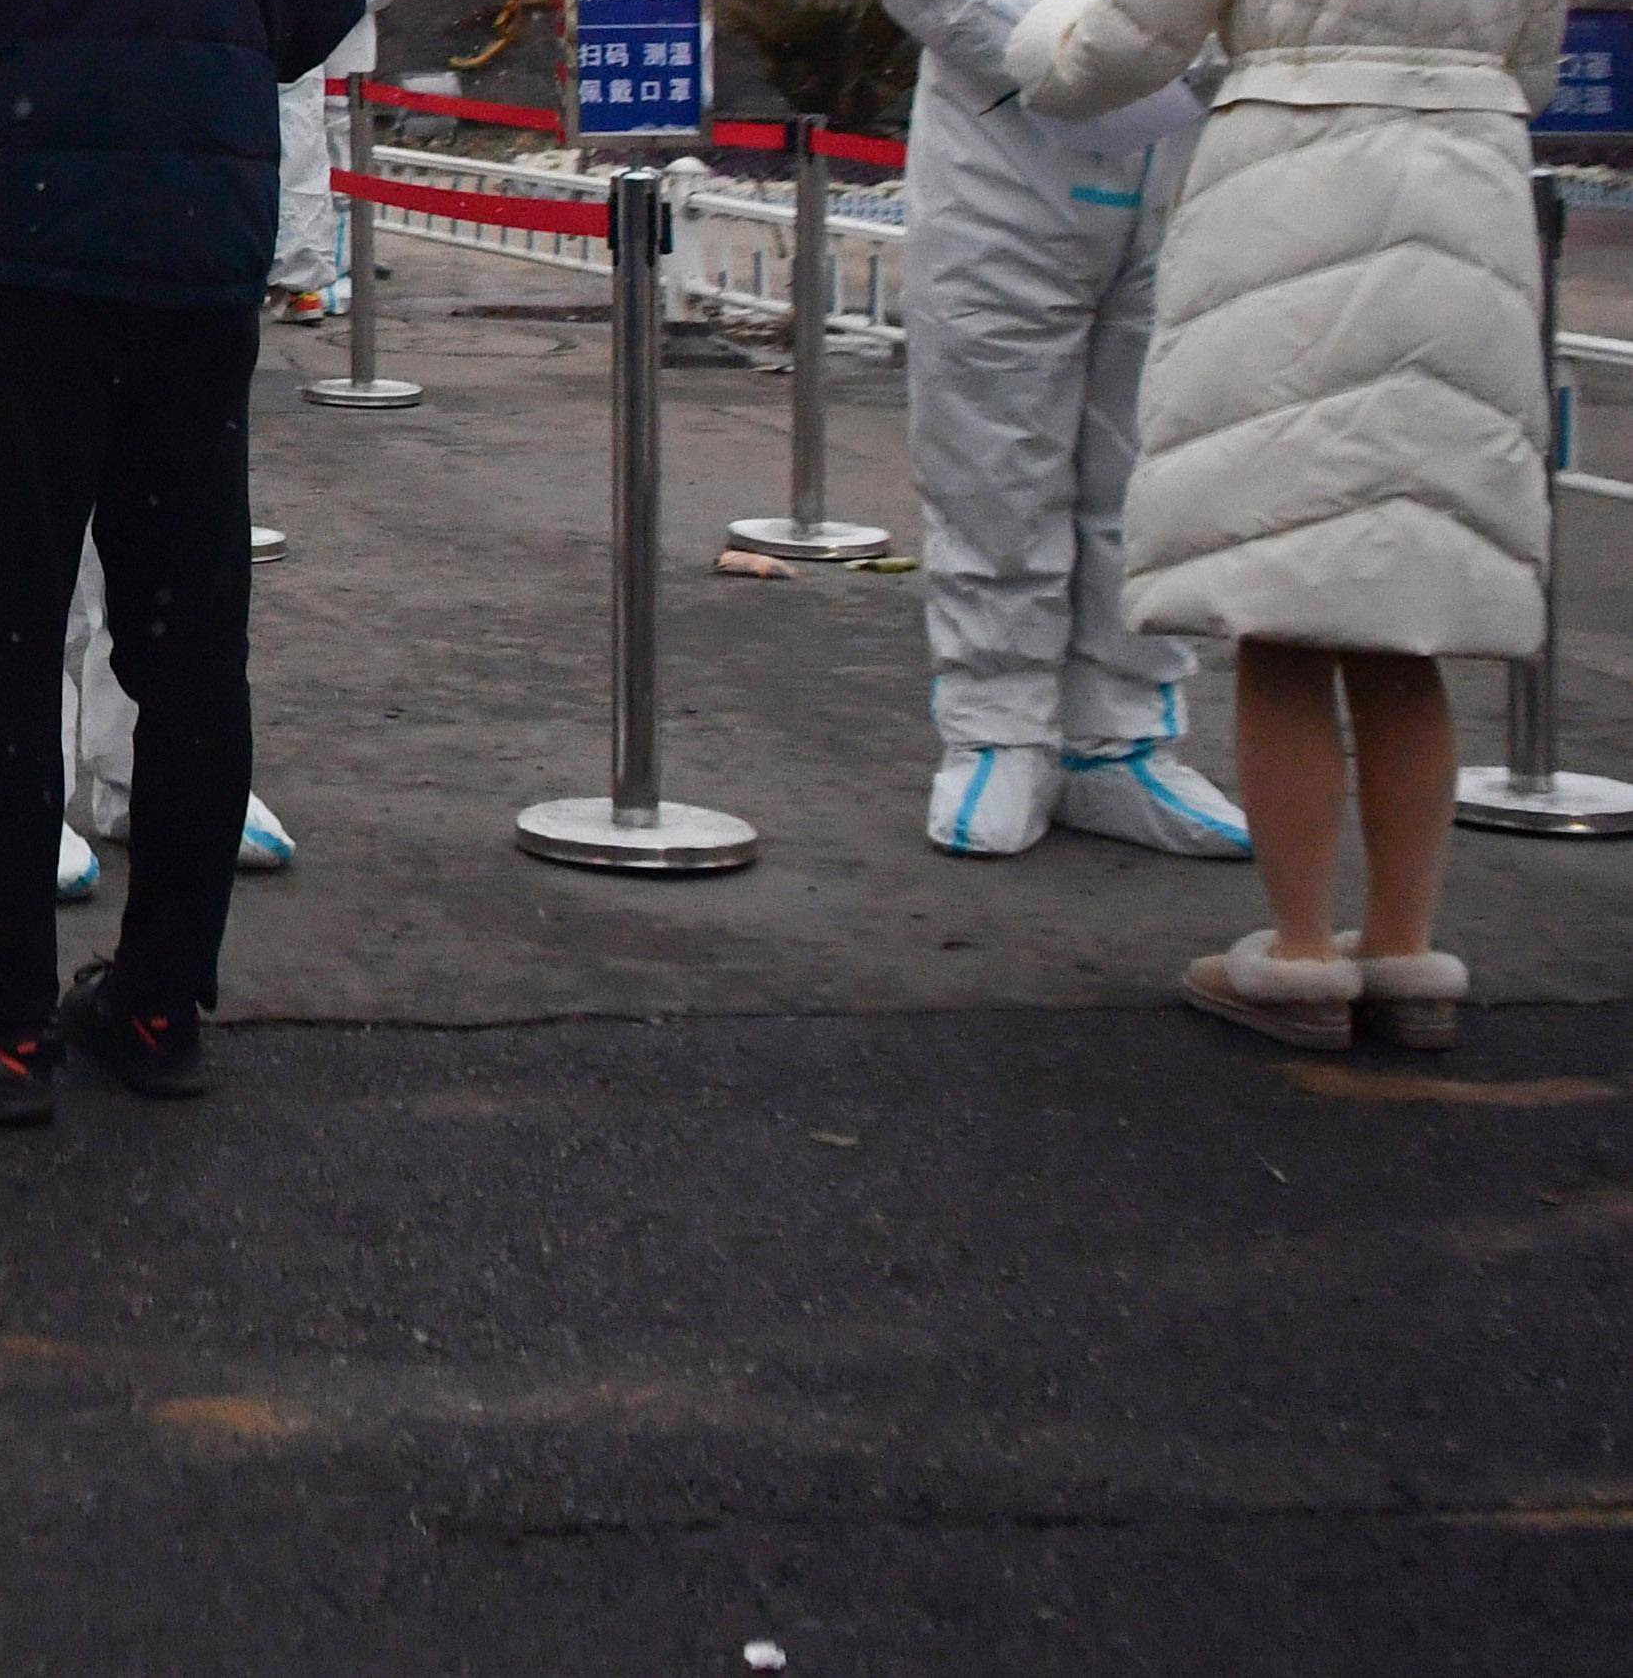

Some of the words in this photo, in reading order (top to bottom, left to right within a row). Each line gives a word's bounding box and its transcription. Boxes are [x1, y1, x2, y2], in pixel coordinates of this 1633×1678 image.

[577, 42, 630, 68] 扫码
[642, 41, 694, 67] 测温
[579, 77, 693, 105] 佩戴口罩
